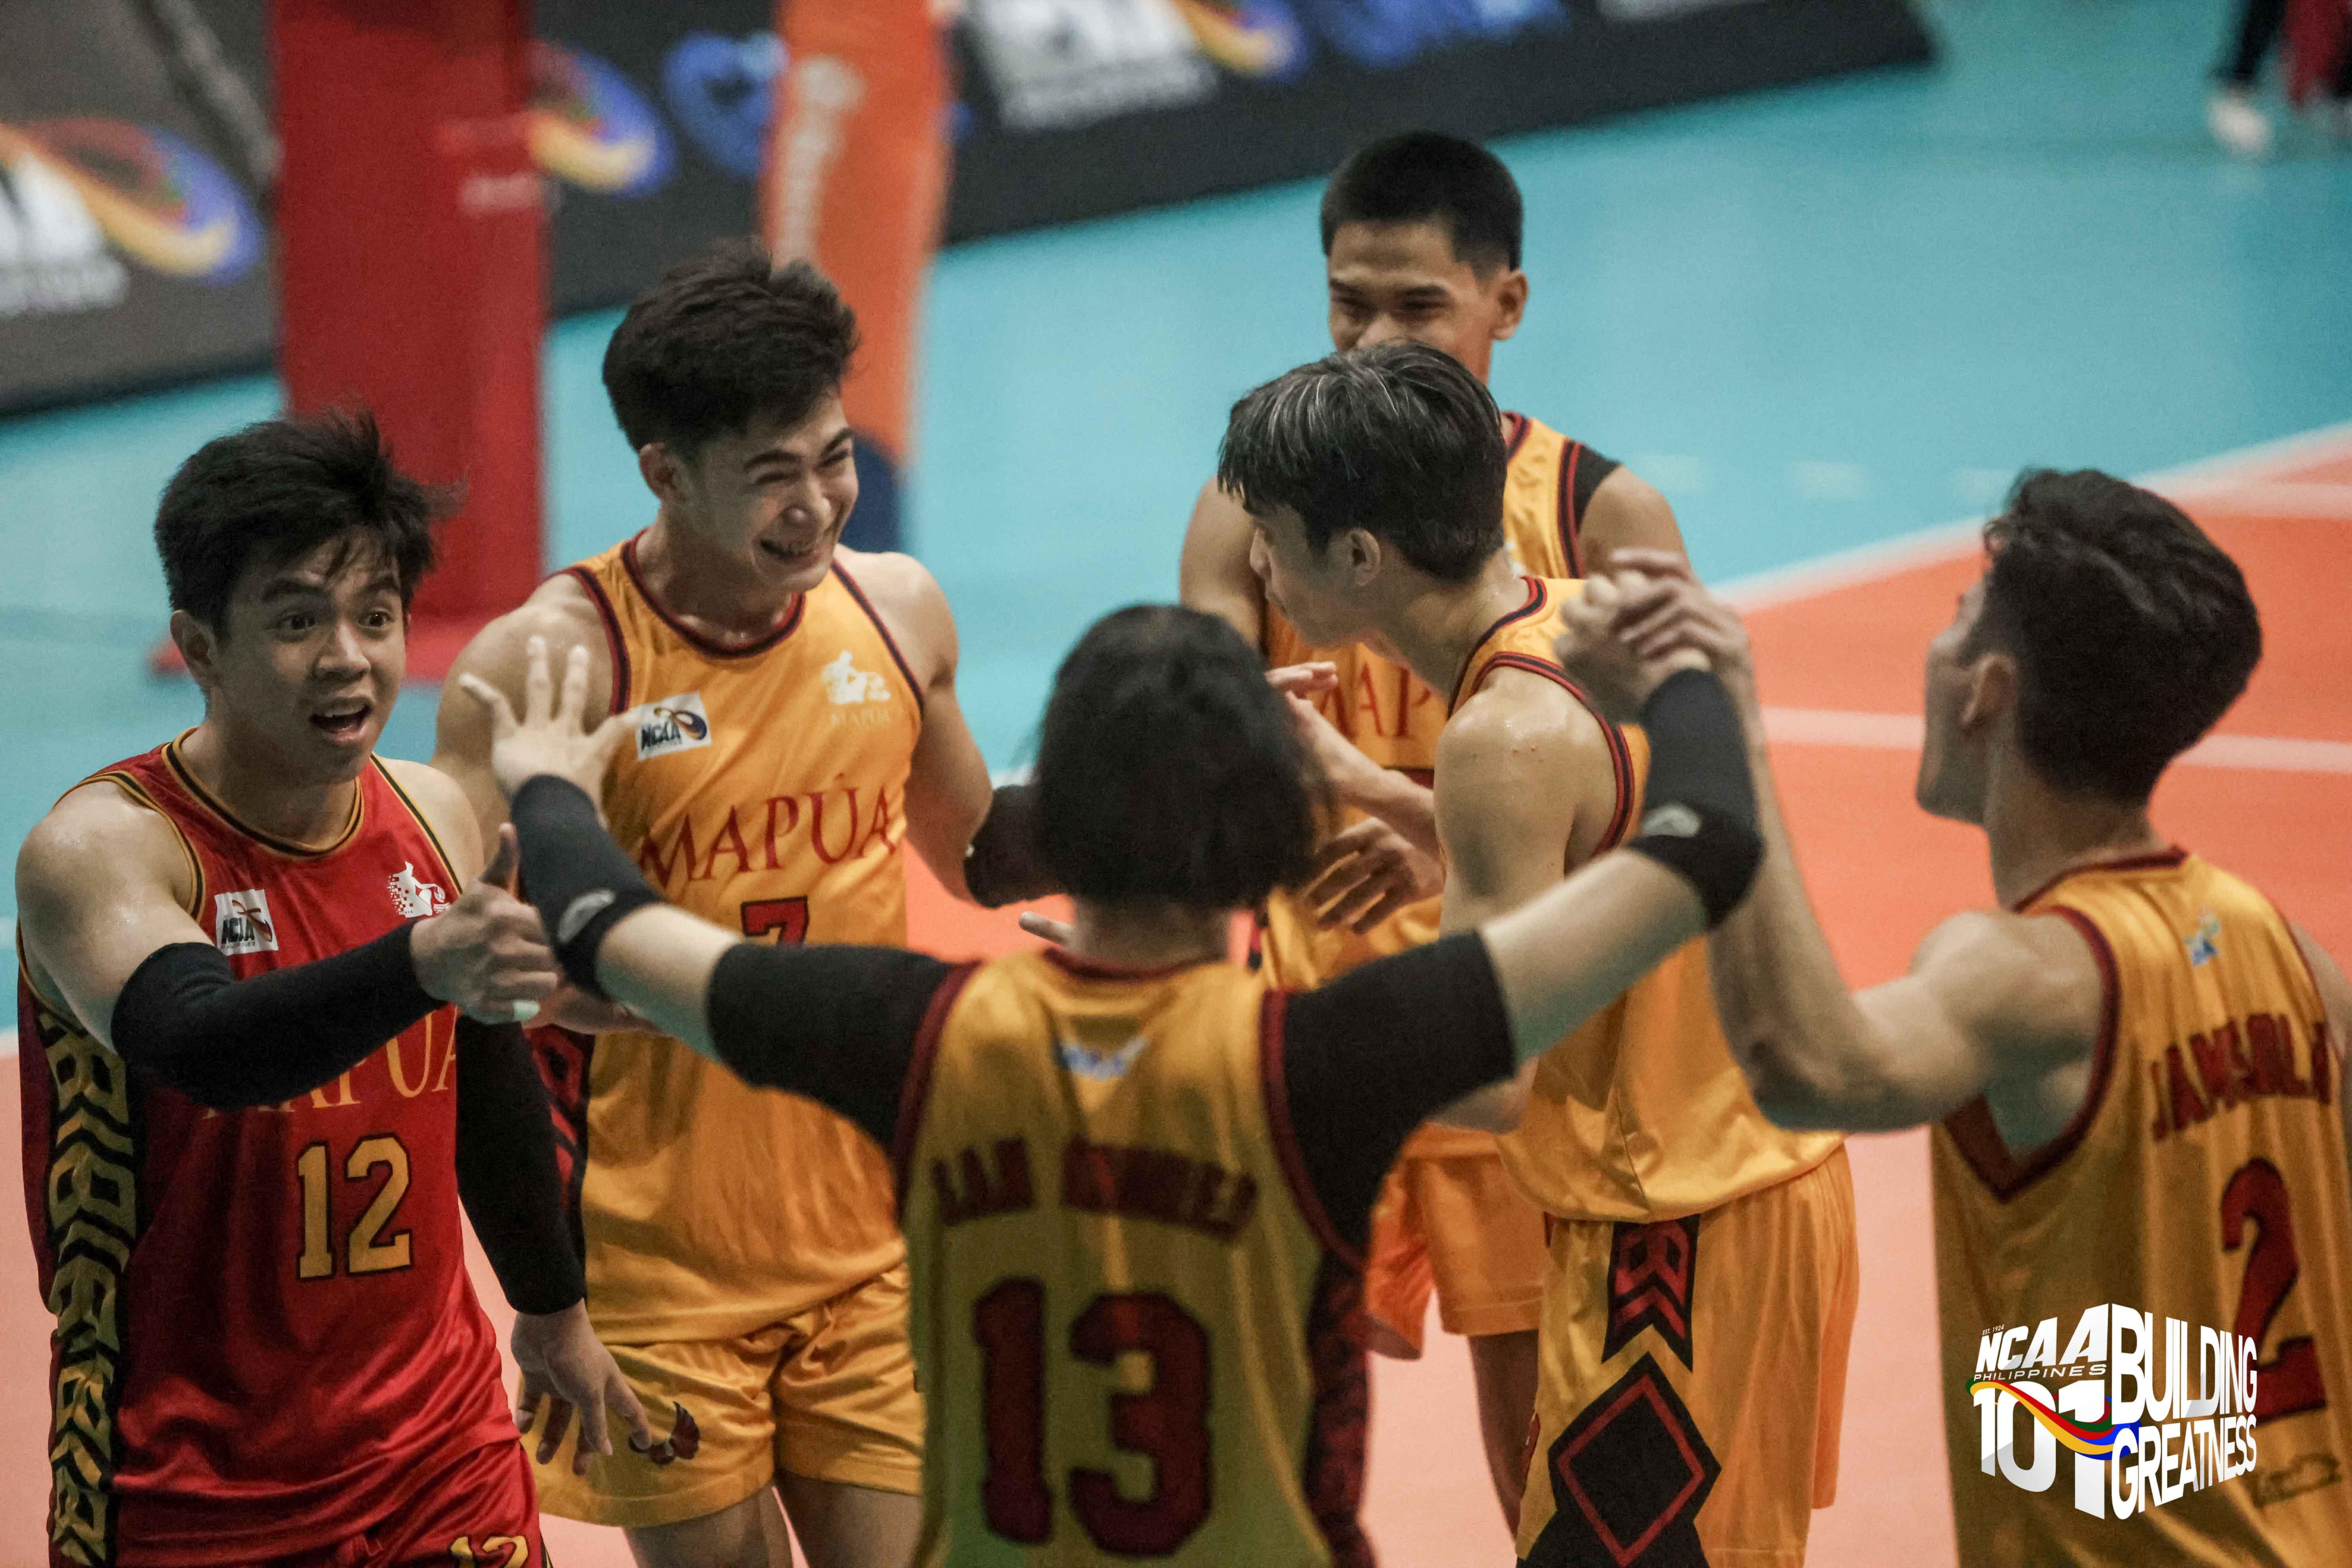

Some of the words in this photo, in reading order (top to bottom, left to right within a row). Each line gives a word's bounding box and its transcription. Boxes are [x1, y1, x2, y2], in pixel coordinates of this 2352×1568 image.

[297, 1132, 412, 1280] 12
[2220, 1156, 2328, 1427] 2
[971, 1274, 1213, 1560] 13
